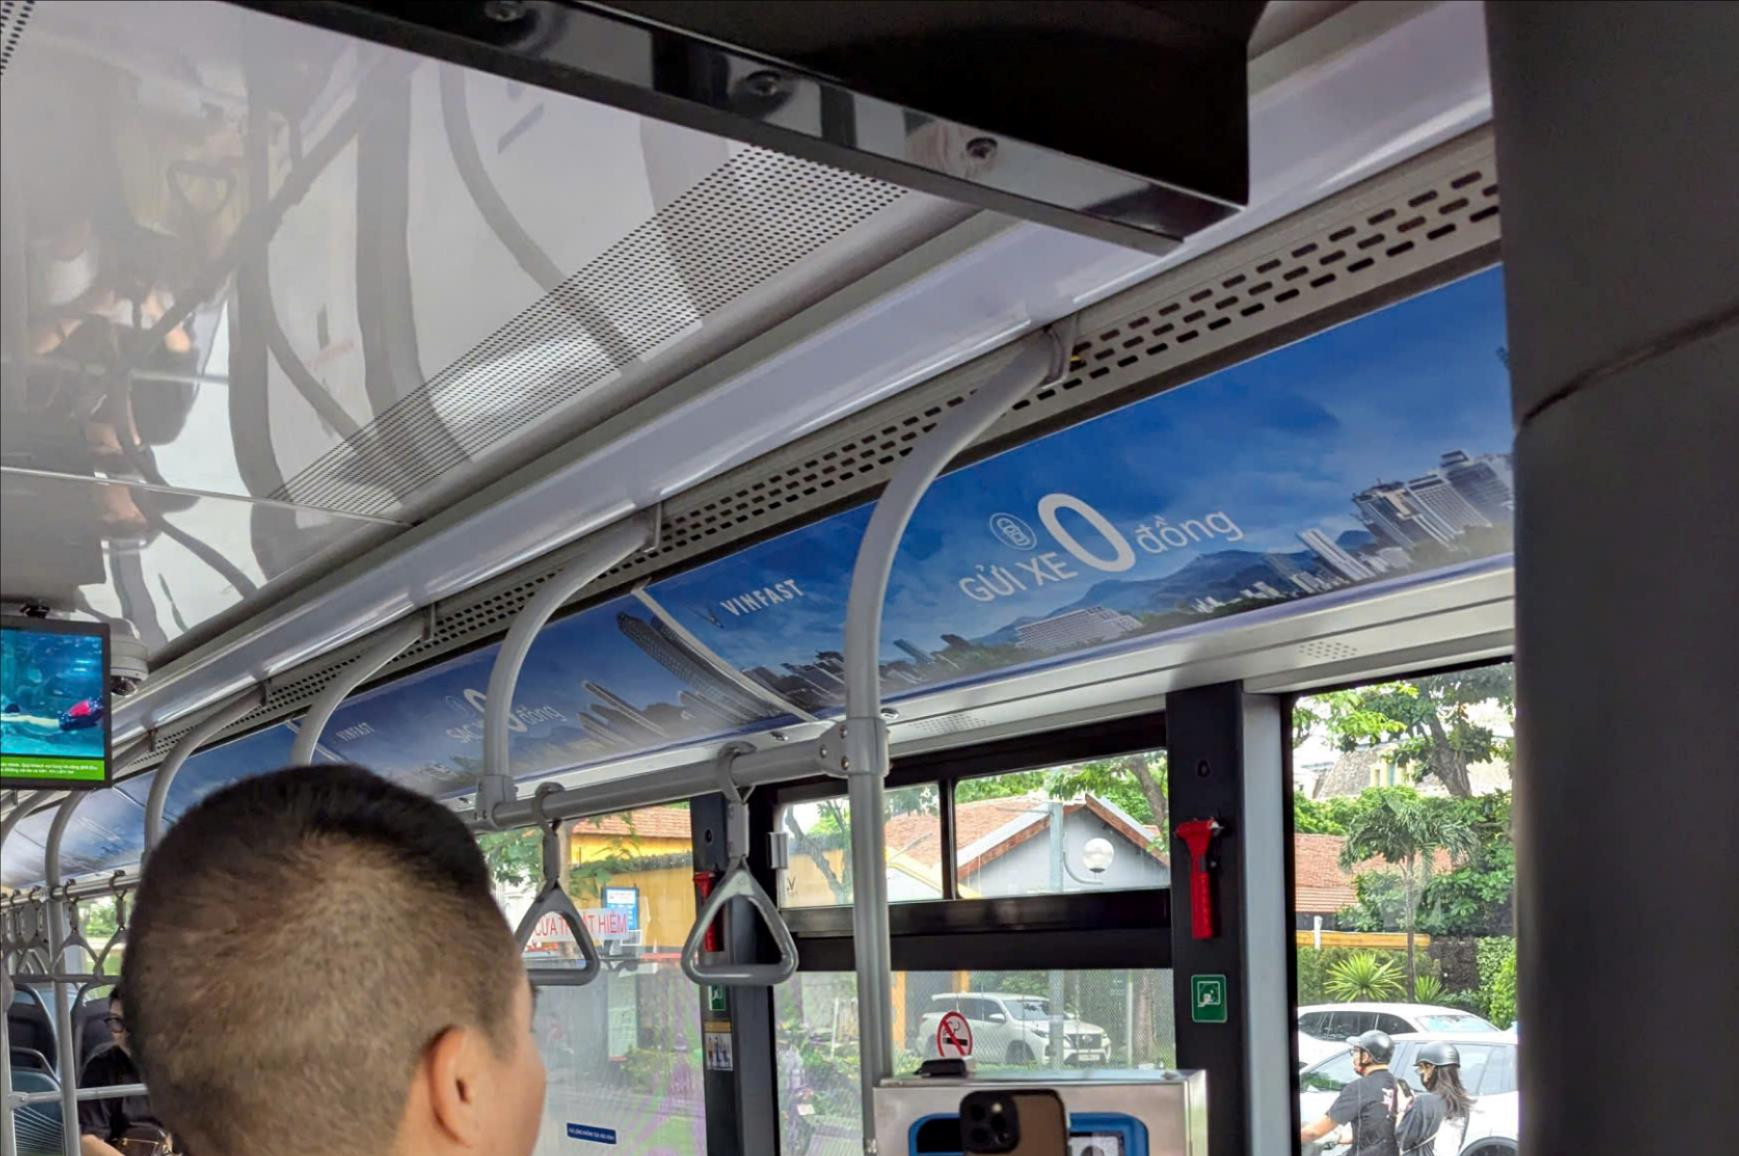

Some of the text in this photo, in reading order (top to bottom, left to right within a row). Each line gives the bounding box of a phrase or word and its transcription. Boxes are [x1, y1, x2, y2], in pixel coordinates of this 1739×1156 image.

[959, 493, 1244, 602] GỬI XE 0 đồng
[720, 579, 804, 616] VINFAST
